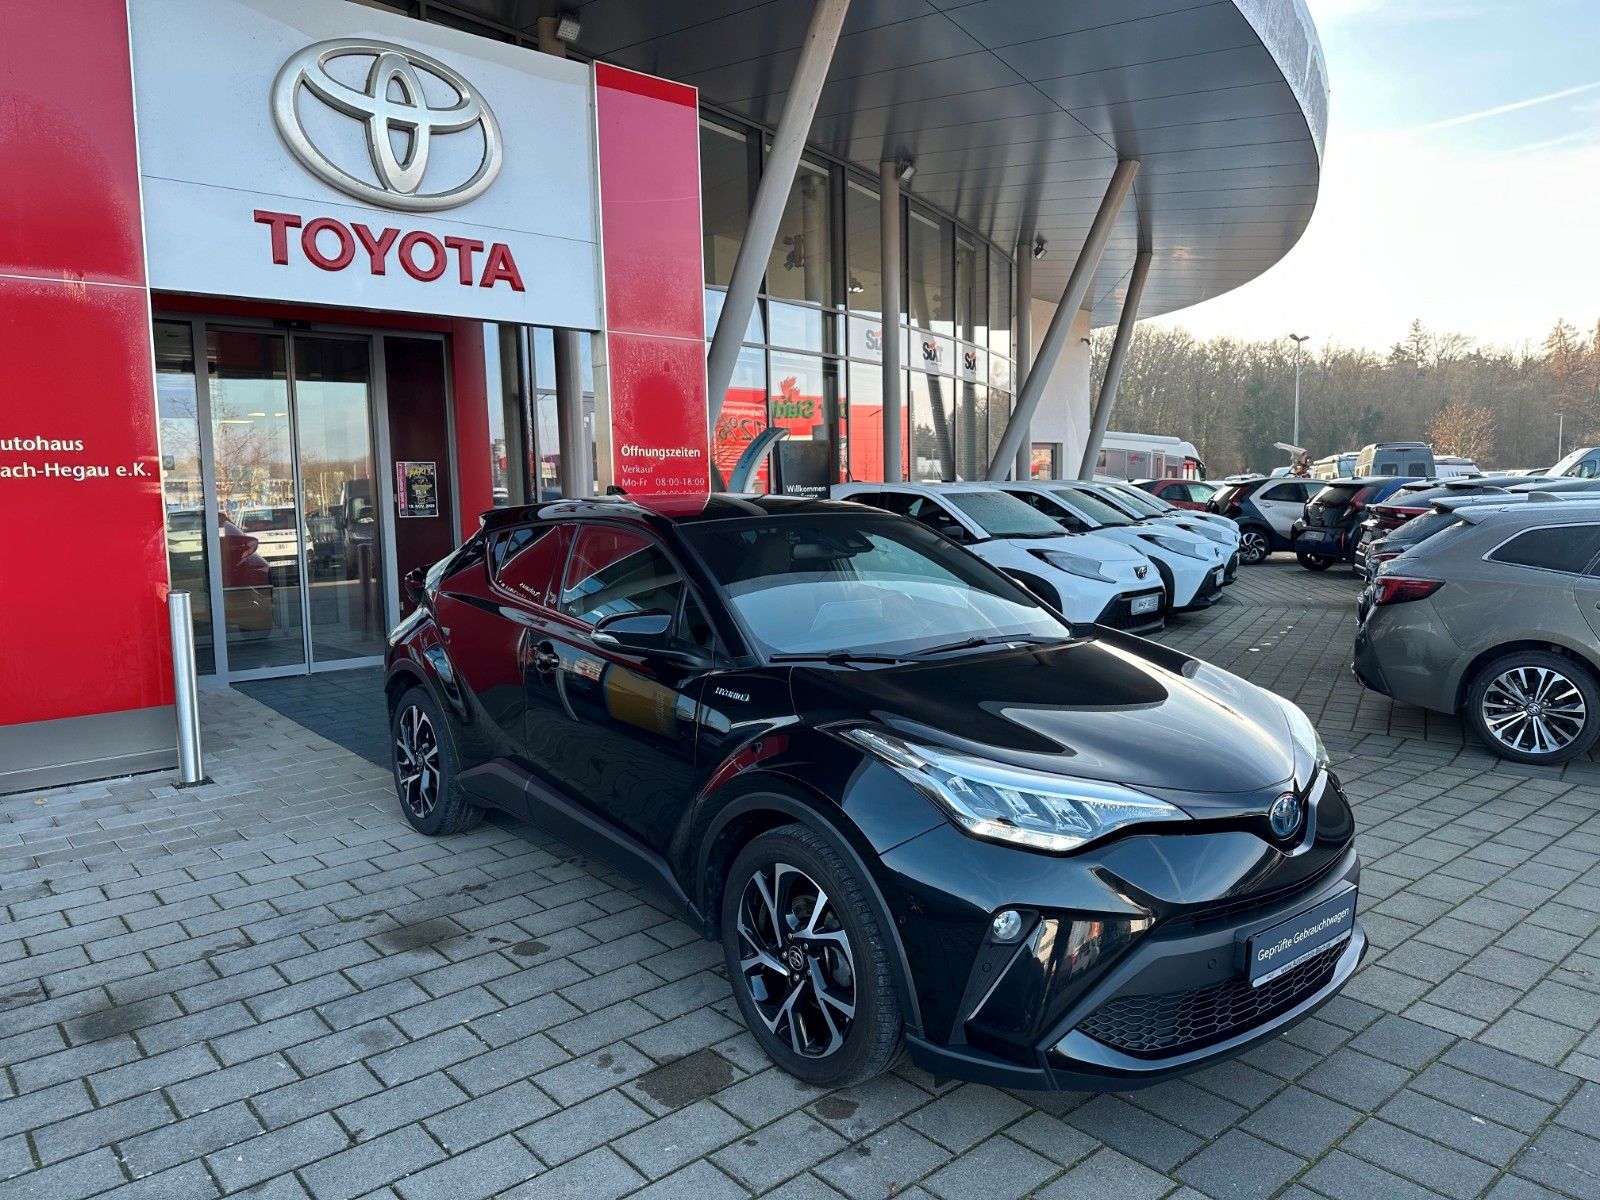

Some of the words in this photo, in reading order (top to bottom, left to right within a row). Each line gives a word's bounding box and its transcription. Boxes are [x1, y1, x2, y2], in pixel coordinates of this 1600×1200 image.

[253, 209, 526, 293] TOYOTA
[621, 444, 701, 460] Öffnungszeiten
[116, 463, 152, 477] e.K.
[621, 465, 654, 474] Verkauf
[621, 478, 647, 487] Mo-Fr
[786, 484, 827, 493] Willkommen
[1257, 937, 1293, 961] Geprüfte
[1293, 907, 1349, 943] Gebrauchtwagen
